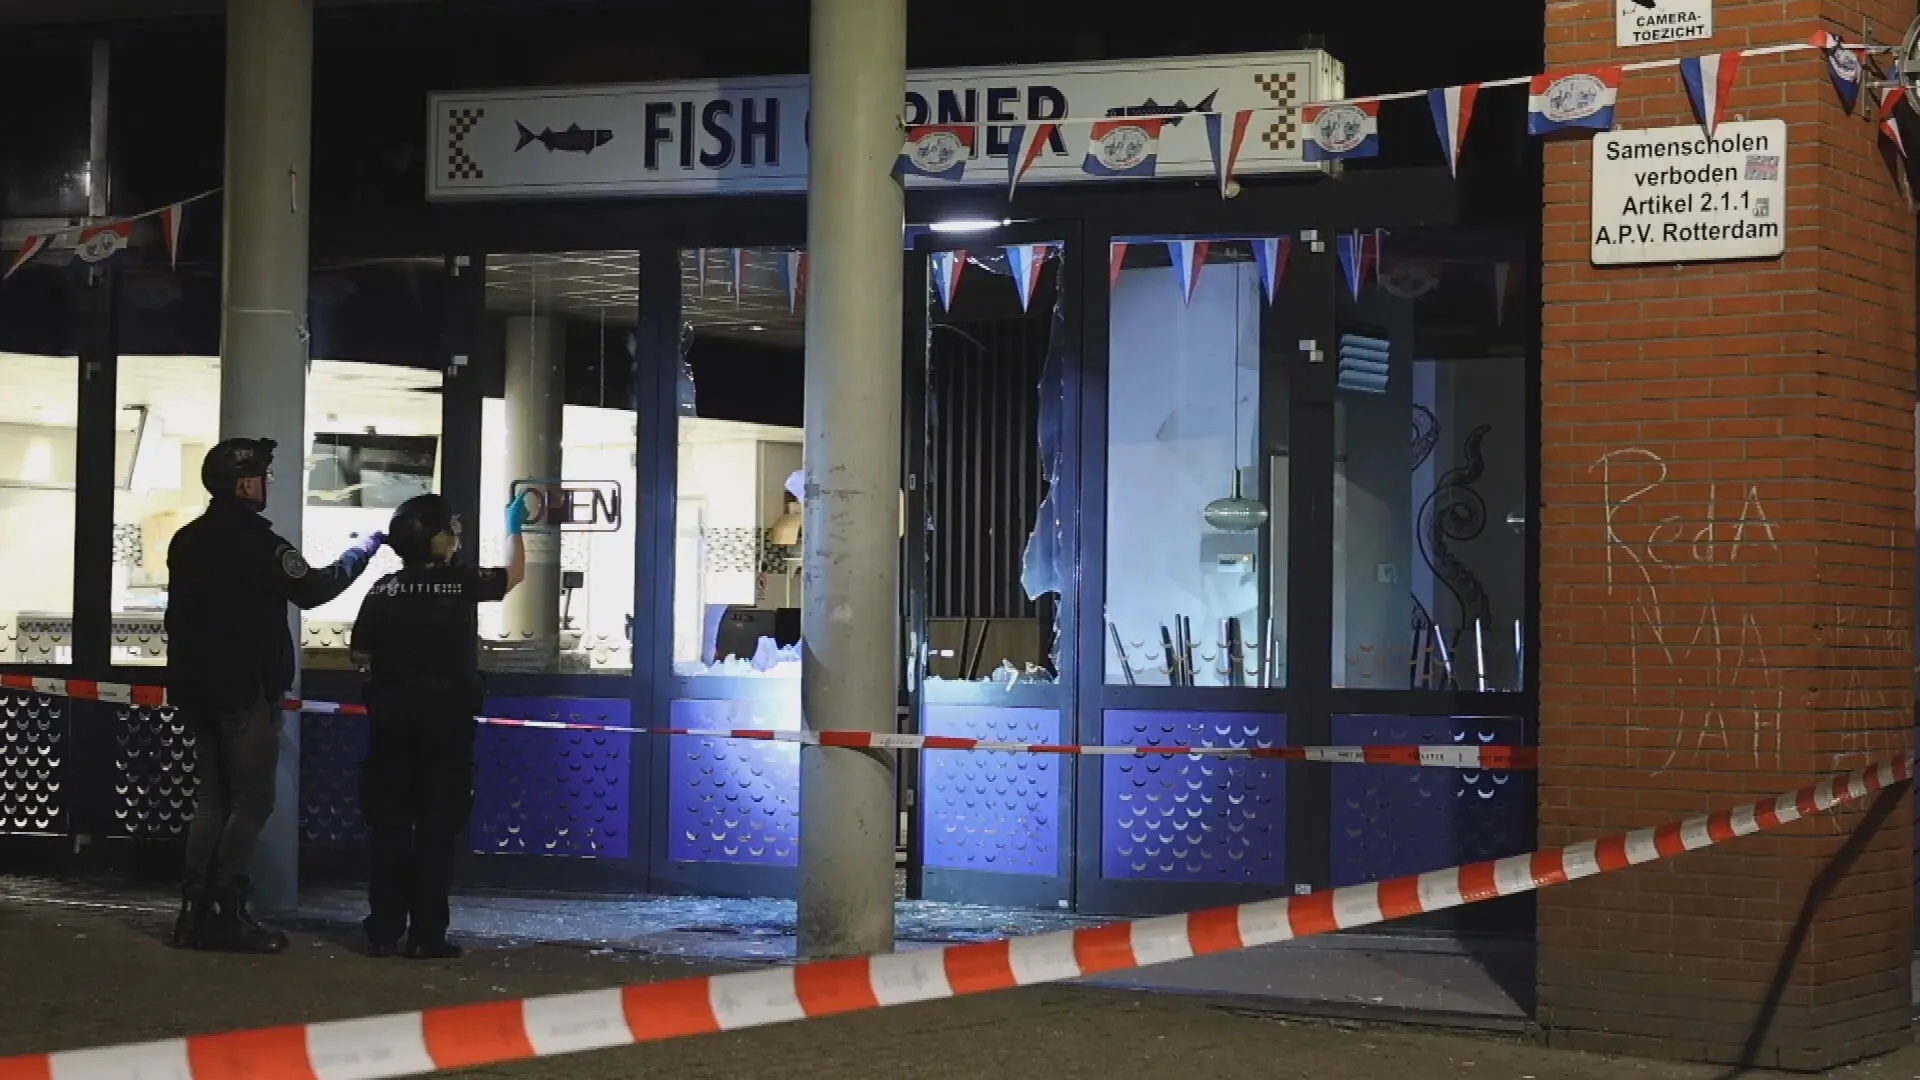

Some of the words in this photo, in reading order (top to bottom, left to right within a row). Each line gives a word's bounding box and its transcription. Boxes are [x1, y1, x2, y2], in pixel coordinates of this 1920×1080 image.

[1636, 11, 1702, 27] CAMERA-
[1632, 24, 1705, 42] TOEZICHT
[644, 97, 783, 171] FISH
[1606, 133, 1769, 161] Samenscholen
[1634, 164, 1738, 187] verboden
[1622, 192, 1693, 216] Artikel
[1700, 190, 1750, 212] 2.1.1
[1595, 223, 1655, 245] A.P.V.
[1663, 219, 1779, 244] Rotterdam
[516, 487, 618, 525] OPEN
